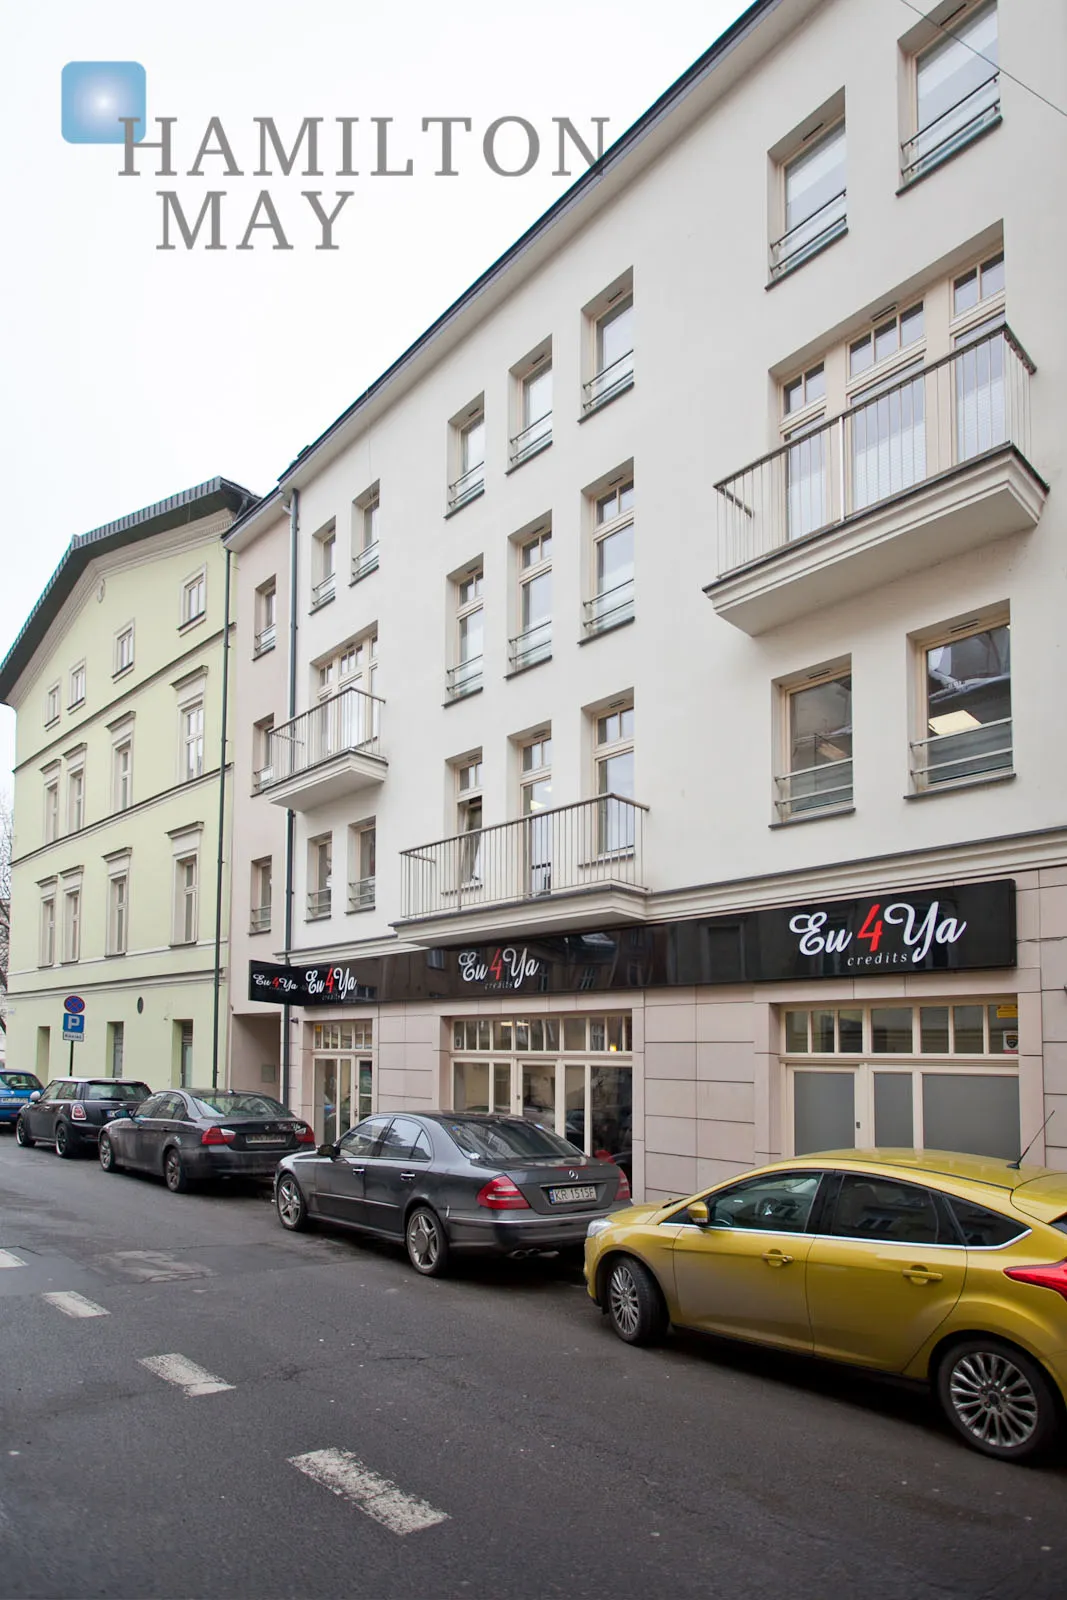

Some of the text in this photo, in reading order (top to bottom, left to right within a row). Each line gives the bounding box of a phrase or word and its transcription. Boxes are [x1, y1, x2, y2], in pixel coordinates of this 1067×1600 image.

[847, 952, 908, 966] credits
[67, 1015, 81, 1030] P
[555, 1190, 568, 1200] KR
